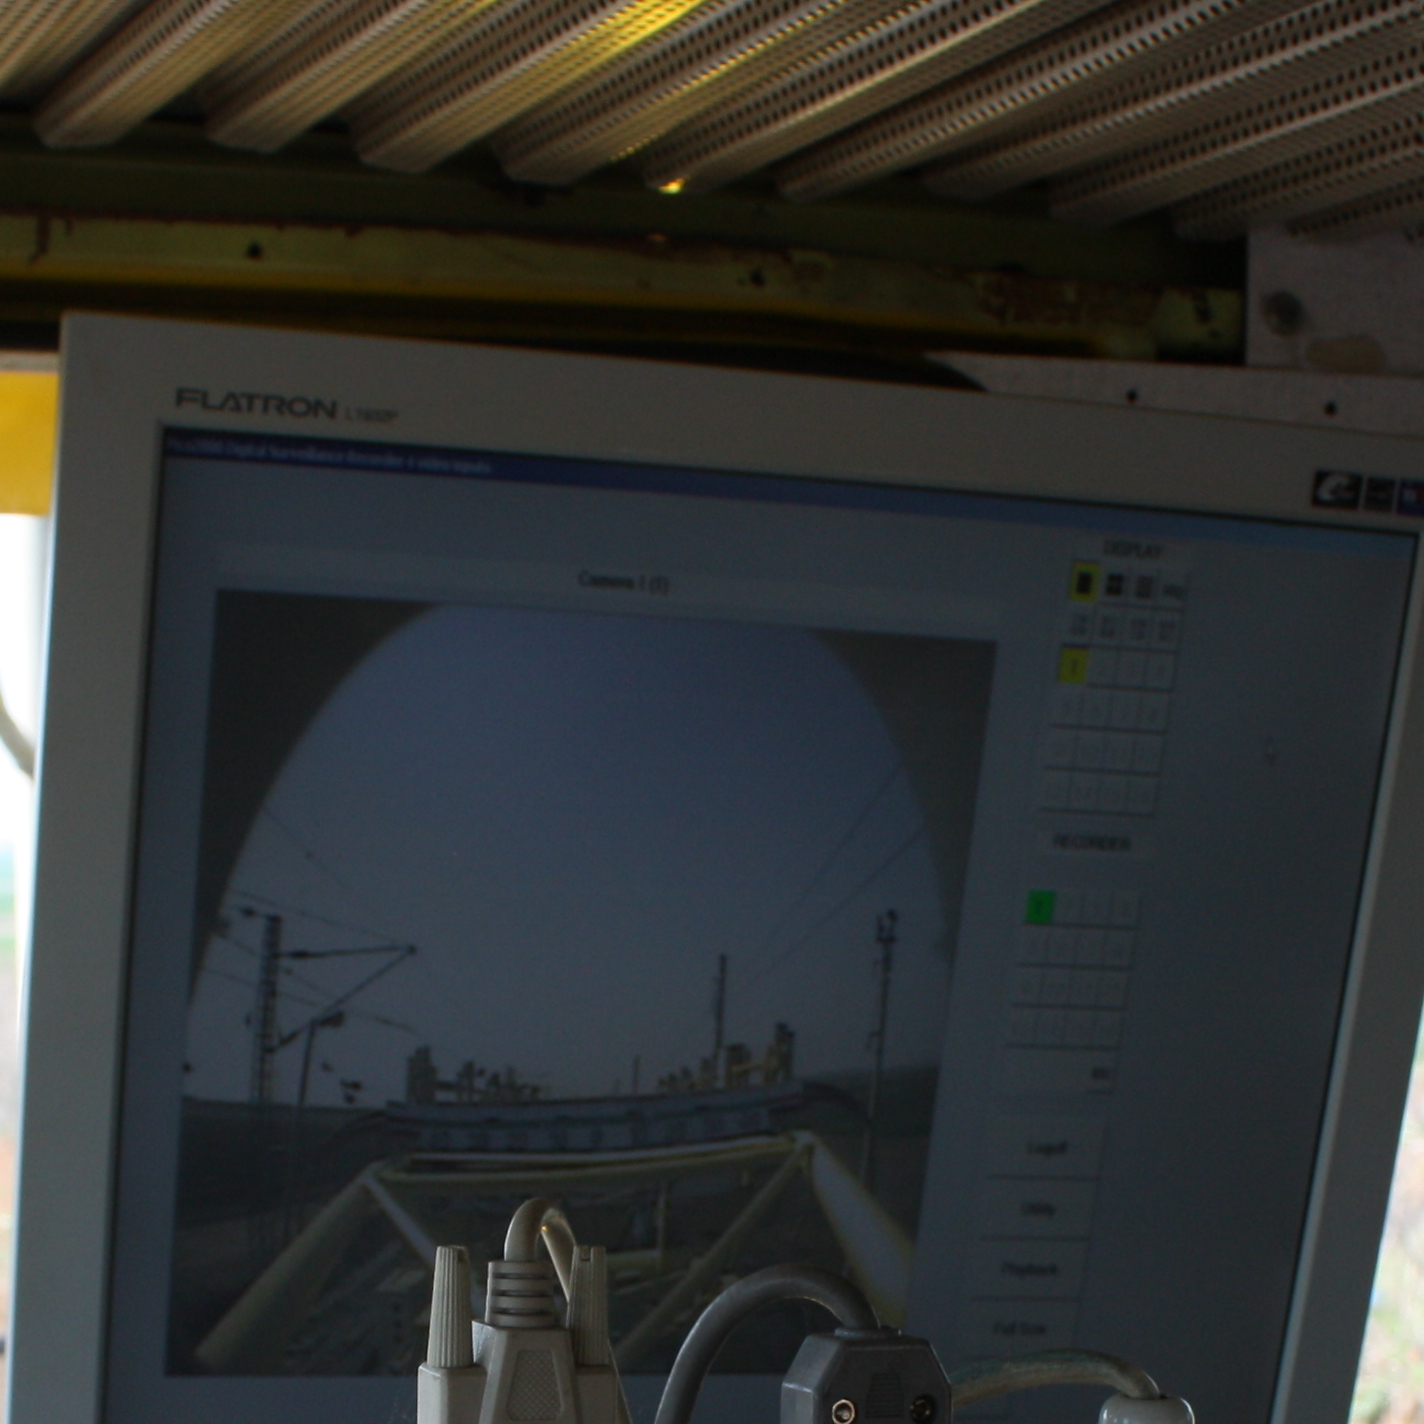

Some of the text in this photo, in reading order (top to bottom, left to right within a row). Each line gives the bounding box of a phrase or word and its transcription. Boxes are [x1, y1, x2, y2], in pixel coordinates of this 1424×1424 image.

[174, 387, 338, 420] FLATRON
[1103, 539, 1166, 559] DISPLAY
[1052, 833, 1133, 852] RECORDER
